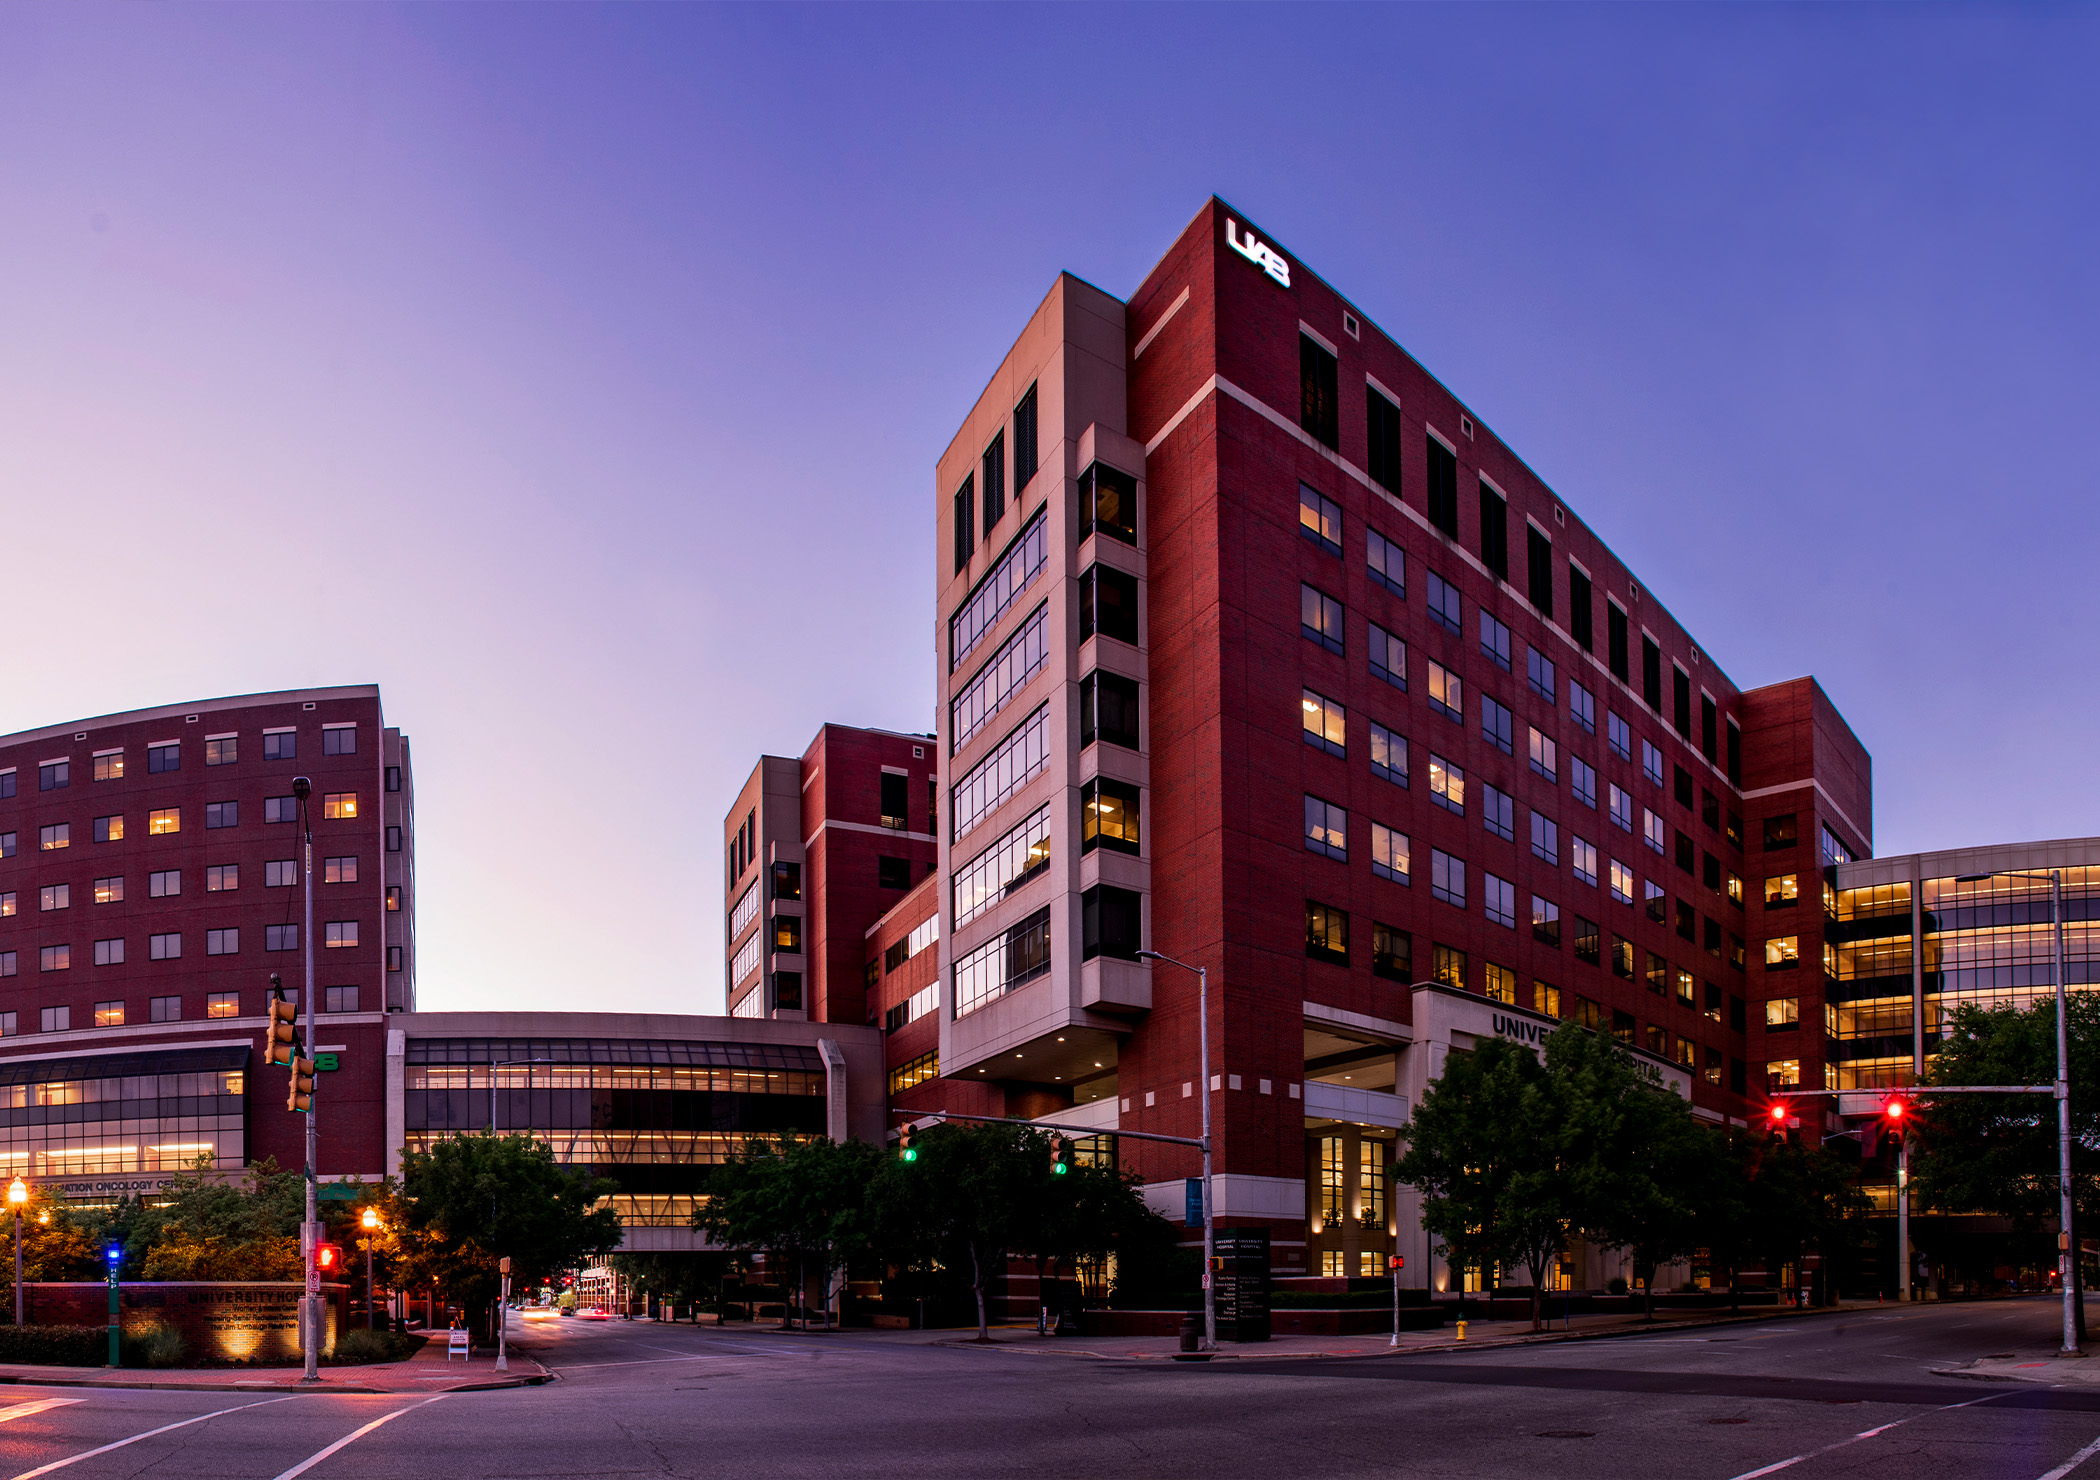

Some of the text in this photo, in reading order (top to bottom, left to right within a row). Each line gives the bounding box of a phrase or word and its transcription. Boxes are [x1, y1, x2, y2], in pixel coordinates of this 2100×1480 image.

[1226, 217, 1290, 289] UAB
[1493, 1013, 1553, 1045] UNIVE
[314, 1053, 339, 1072] AB
[96, 1181, 153, 1191] ONCOLOGY
[187, 1291, 273, 1304] UNIVERSITY
